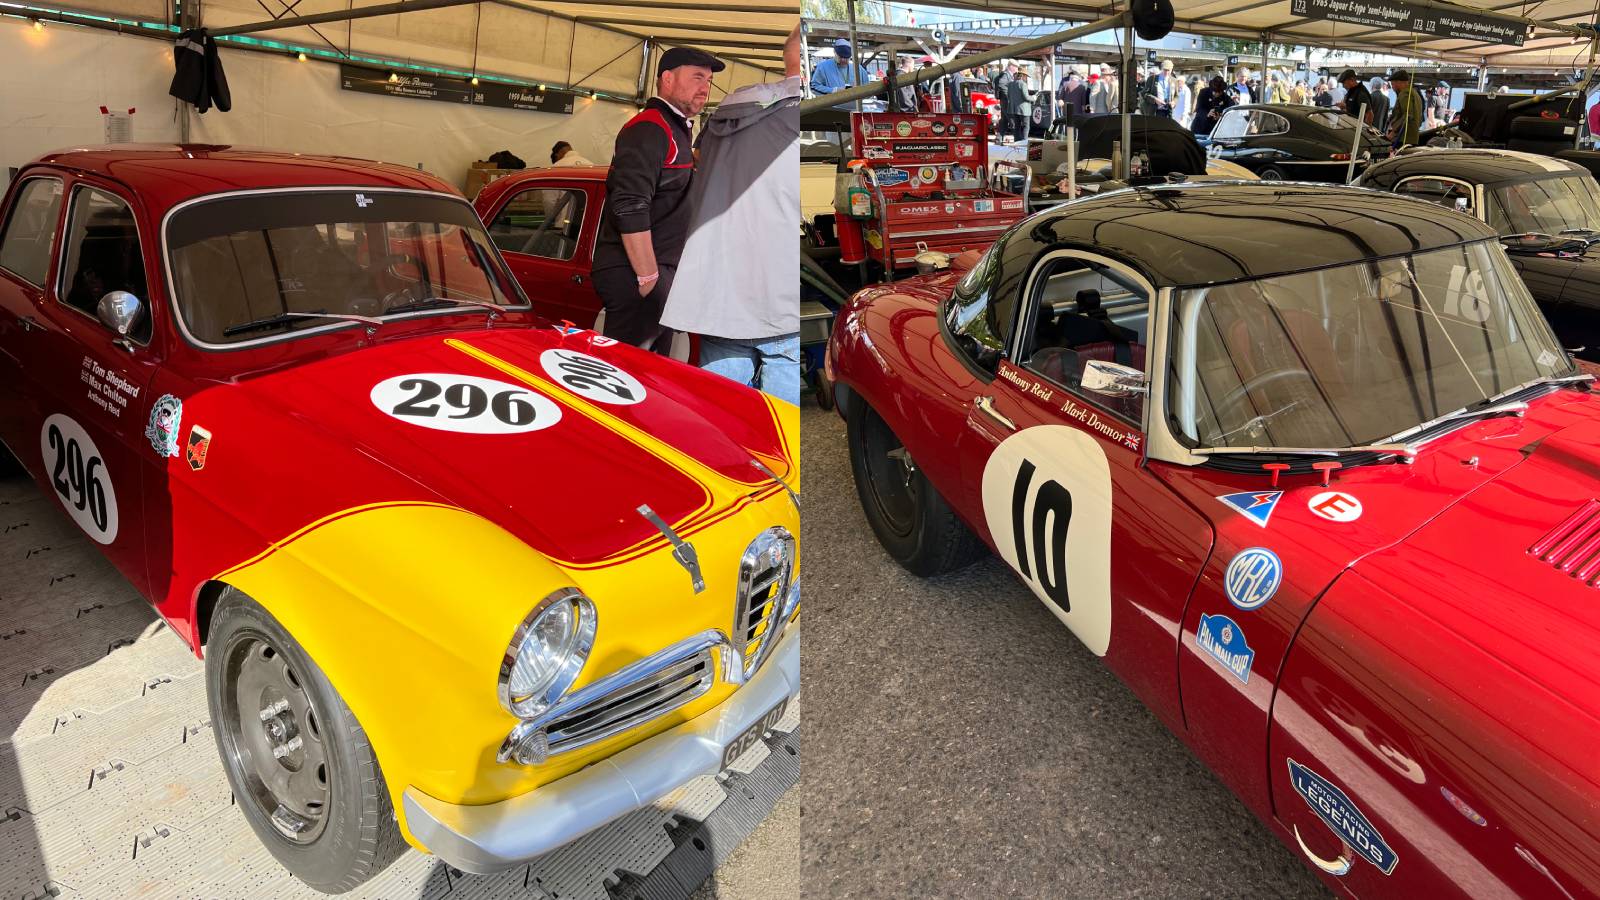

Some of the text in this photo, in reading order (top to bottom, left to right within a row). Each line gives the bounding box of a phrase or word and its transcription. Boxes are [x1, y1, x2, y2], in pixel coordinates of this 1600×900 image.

[1329, 0, 1349, 12] Jaguar
[1349, 2, 1367, 15] E-type
[88, 375, 127, 408] Max Chilton
[92, 361, 140, 398] Tom Shephard
[553, 350, 636, 402] 296
[998, 365, 1054, 401] Anthony Reid
[87, 390, 121, 418] Anthony Reid
[392, 378, 537, 426] 296
[1060, 399, 1126, 443] Mark Donnor
[48, 423, 108, 533] 296
[1312, 493, 1357, 519] E
[1012, 457, 1073, 613] 10
[1230, 553, 1274, 602] MRL
[1199, 620, 1250, 676] PALL MALL CUP
[724, 725, 758, 767] GTS
[1297, 776, 1384, 864] LEGENDS
[1310, 779, 1371, 837] MOTOR RACING
